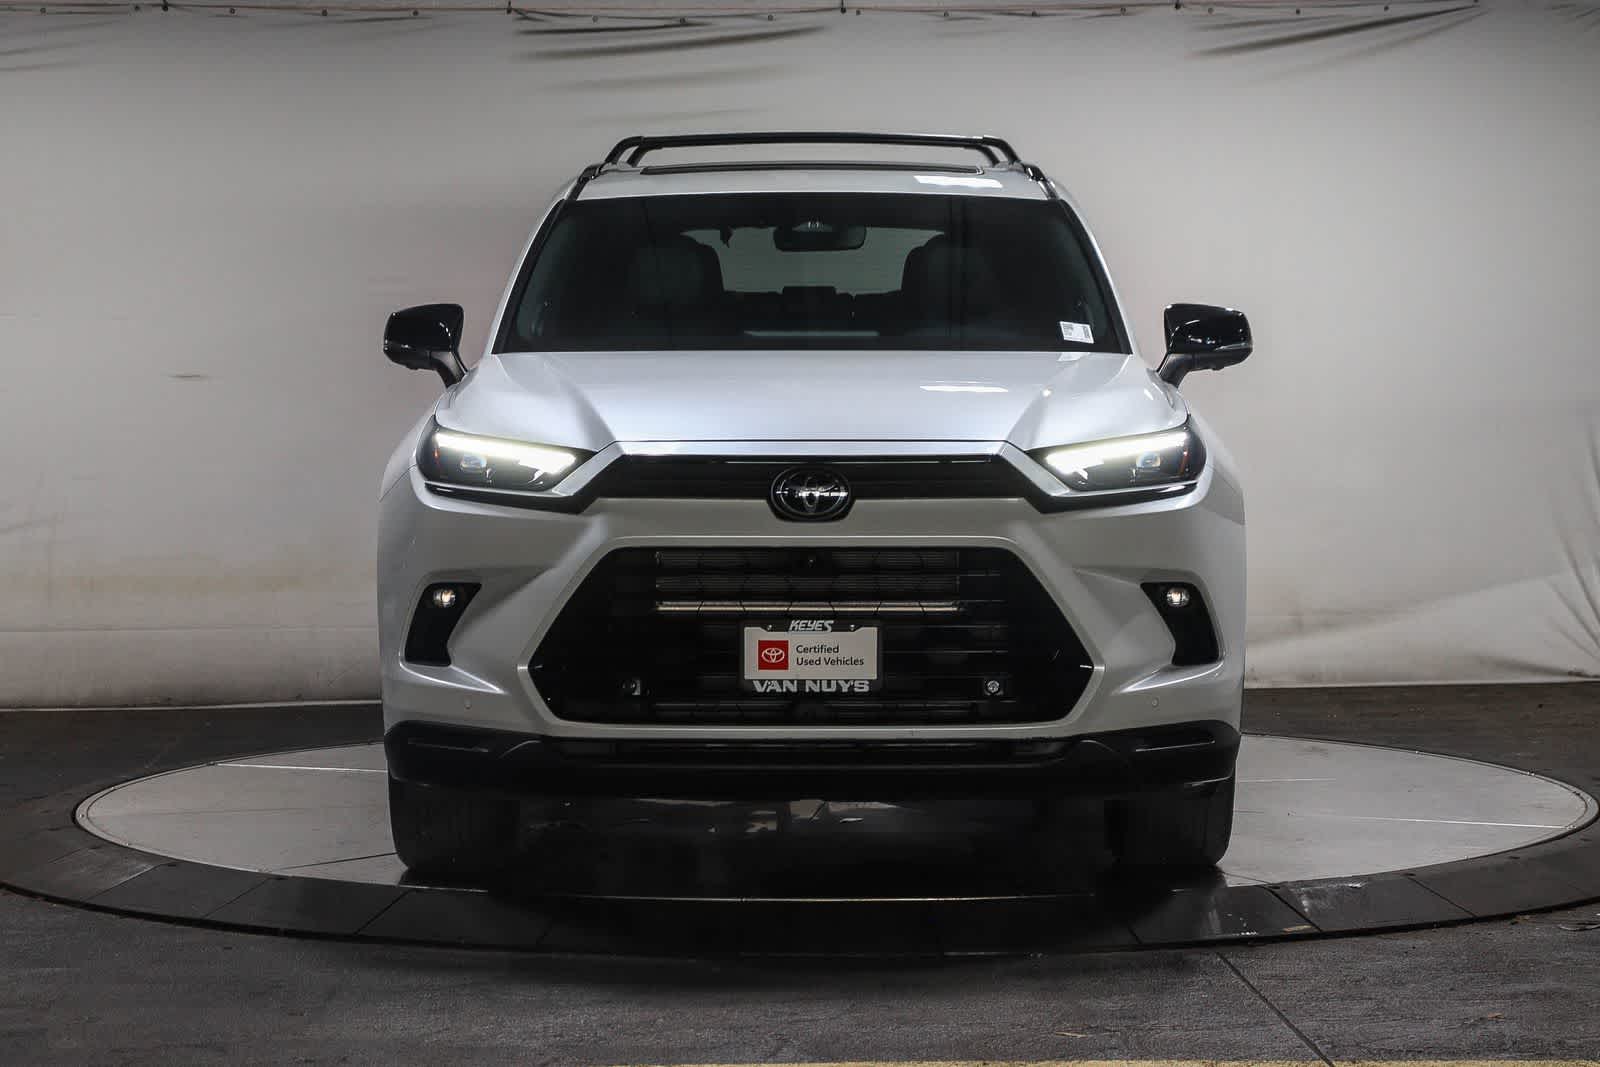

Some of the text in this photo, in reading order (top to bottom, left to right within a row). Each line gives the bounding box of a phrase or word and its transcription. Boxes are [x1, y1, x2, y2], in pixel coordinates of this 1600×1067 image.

[789, 620, 834, 632] KEYES
[796, 645, 840, 654] Certified
[796, 657, 864, 666] Used Vehicles
[752, 680, 870, 693] VAN NUYS
